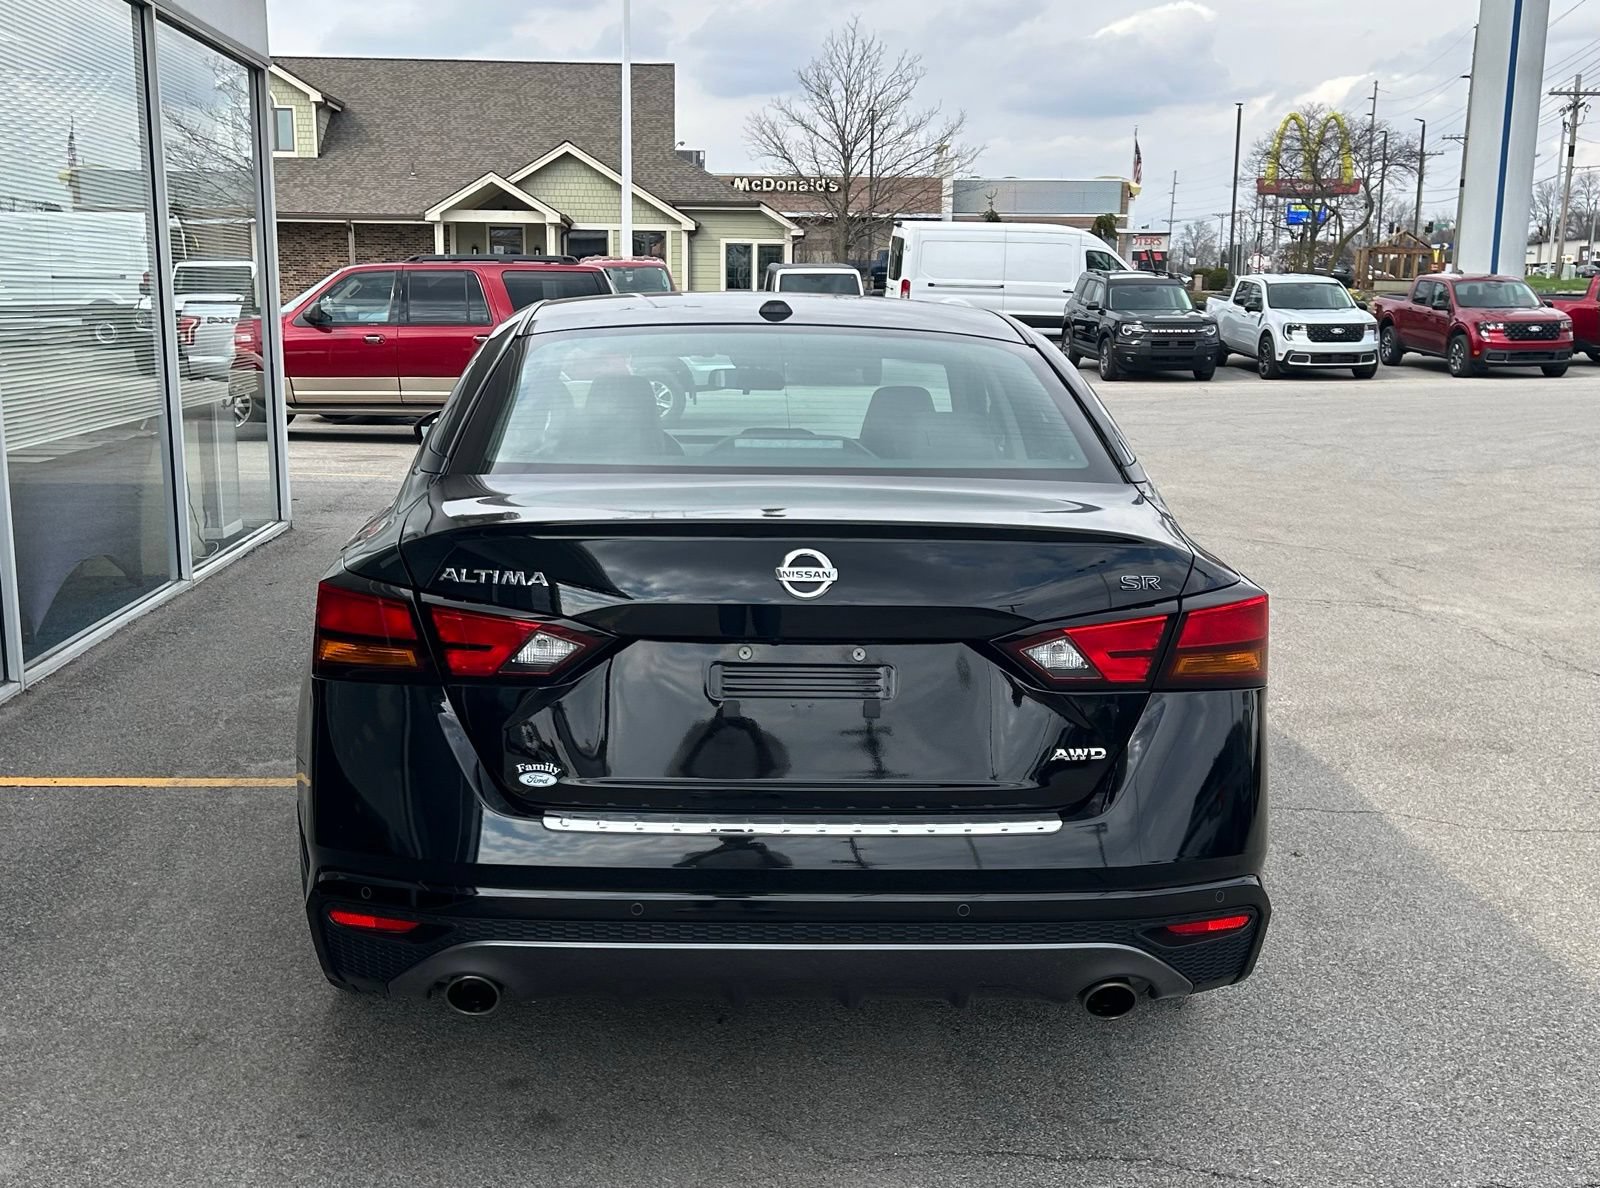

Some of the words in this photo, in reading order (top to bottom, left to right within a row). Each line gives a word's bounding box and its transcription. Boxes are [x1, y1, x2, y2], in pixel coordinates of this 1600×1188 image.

[733, 177, 839, 192] McDonald's
[439, 567, 549, 587] ALTIMA
[782, 570, 831, 579] NISSAN
[1120, 575, 1162, 590] SR
[1049, 747, 1107, 761] AWD
[515, 762, 562, 776] Family
[526, 774, 549, 785] Ford
